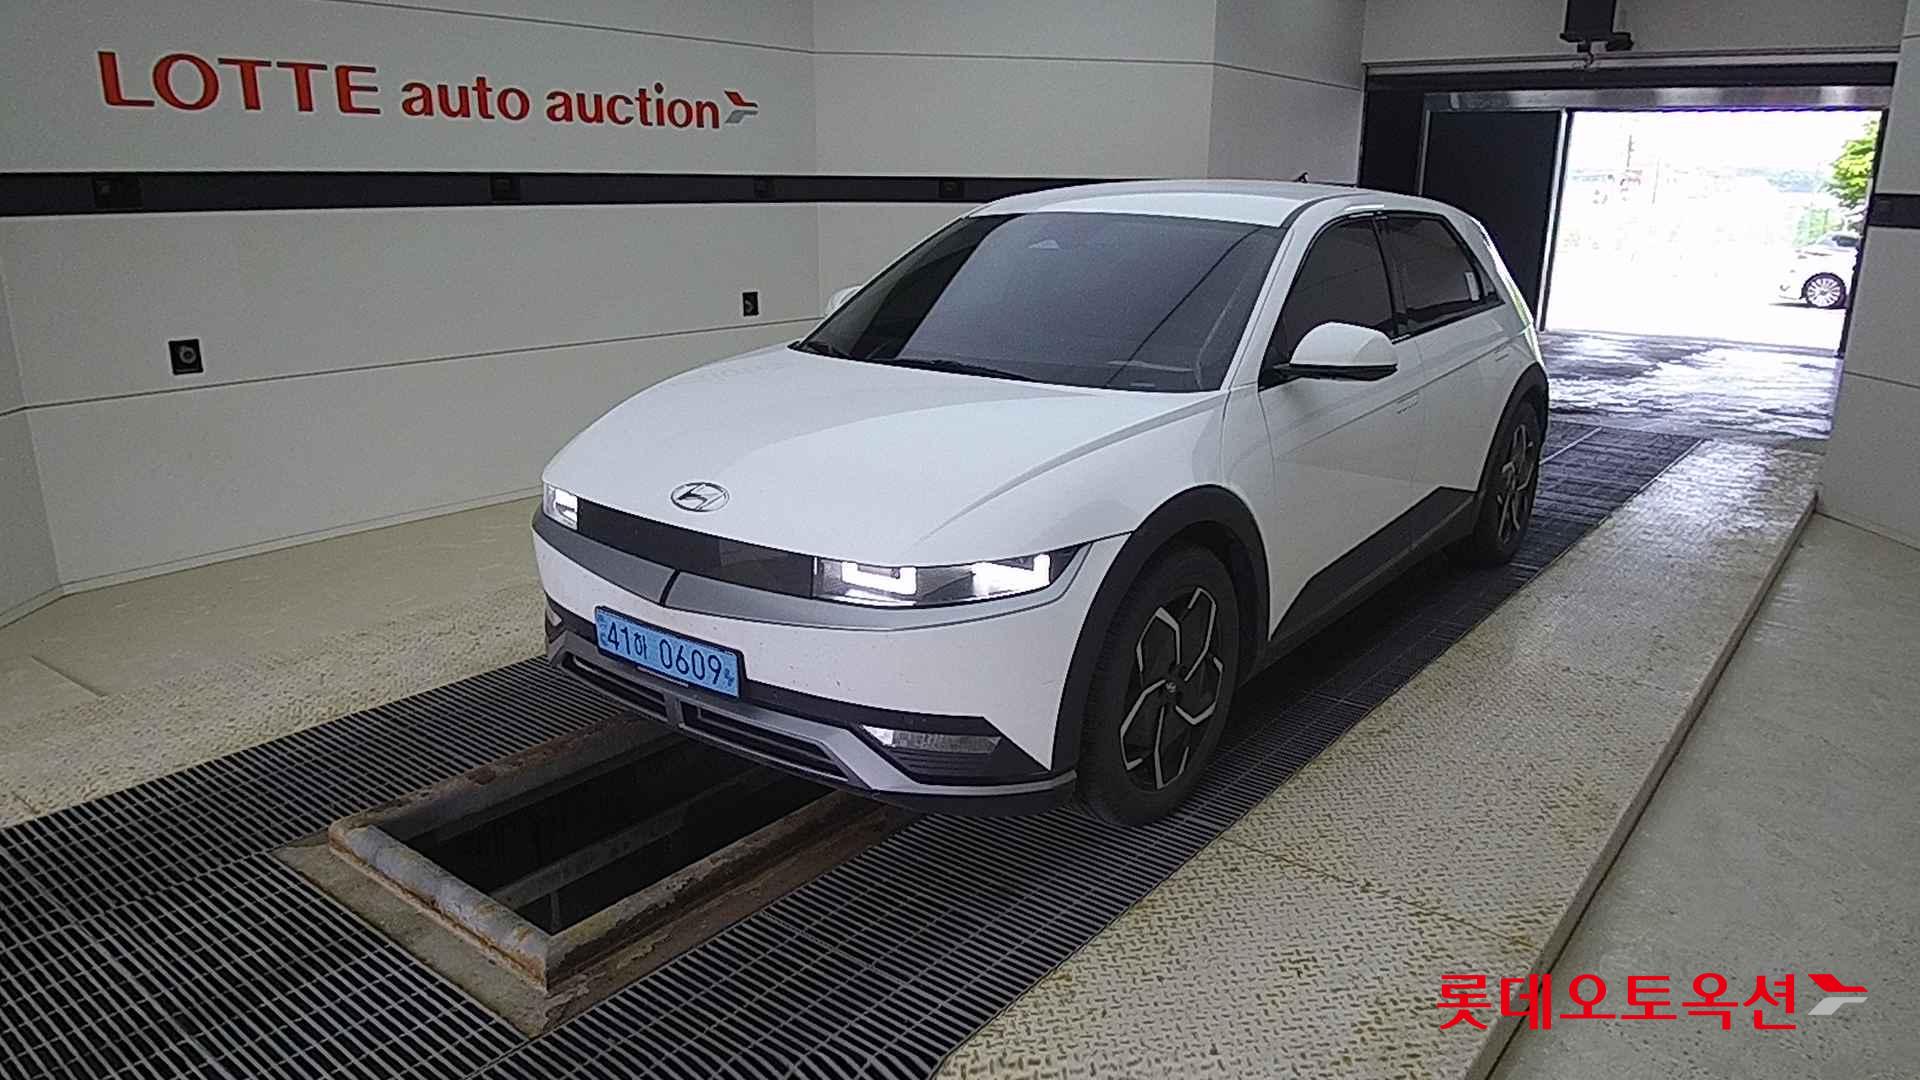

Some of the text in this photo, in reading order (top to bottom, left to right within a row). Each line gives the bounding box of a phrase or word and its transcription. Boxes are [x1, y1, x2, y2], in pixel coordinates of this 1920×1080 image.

[97, 51, 721, 129] LOTTE auto auction
[658, 638, 722, 685] 0609
